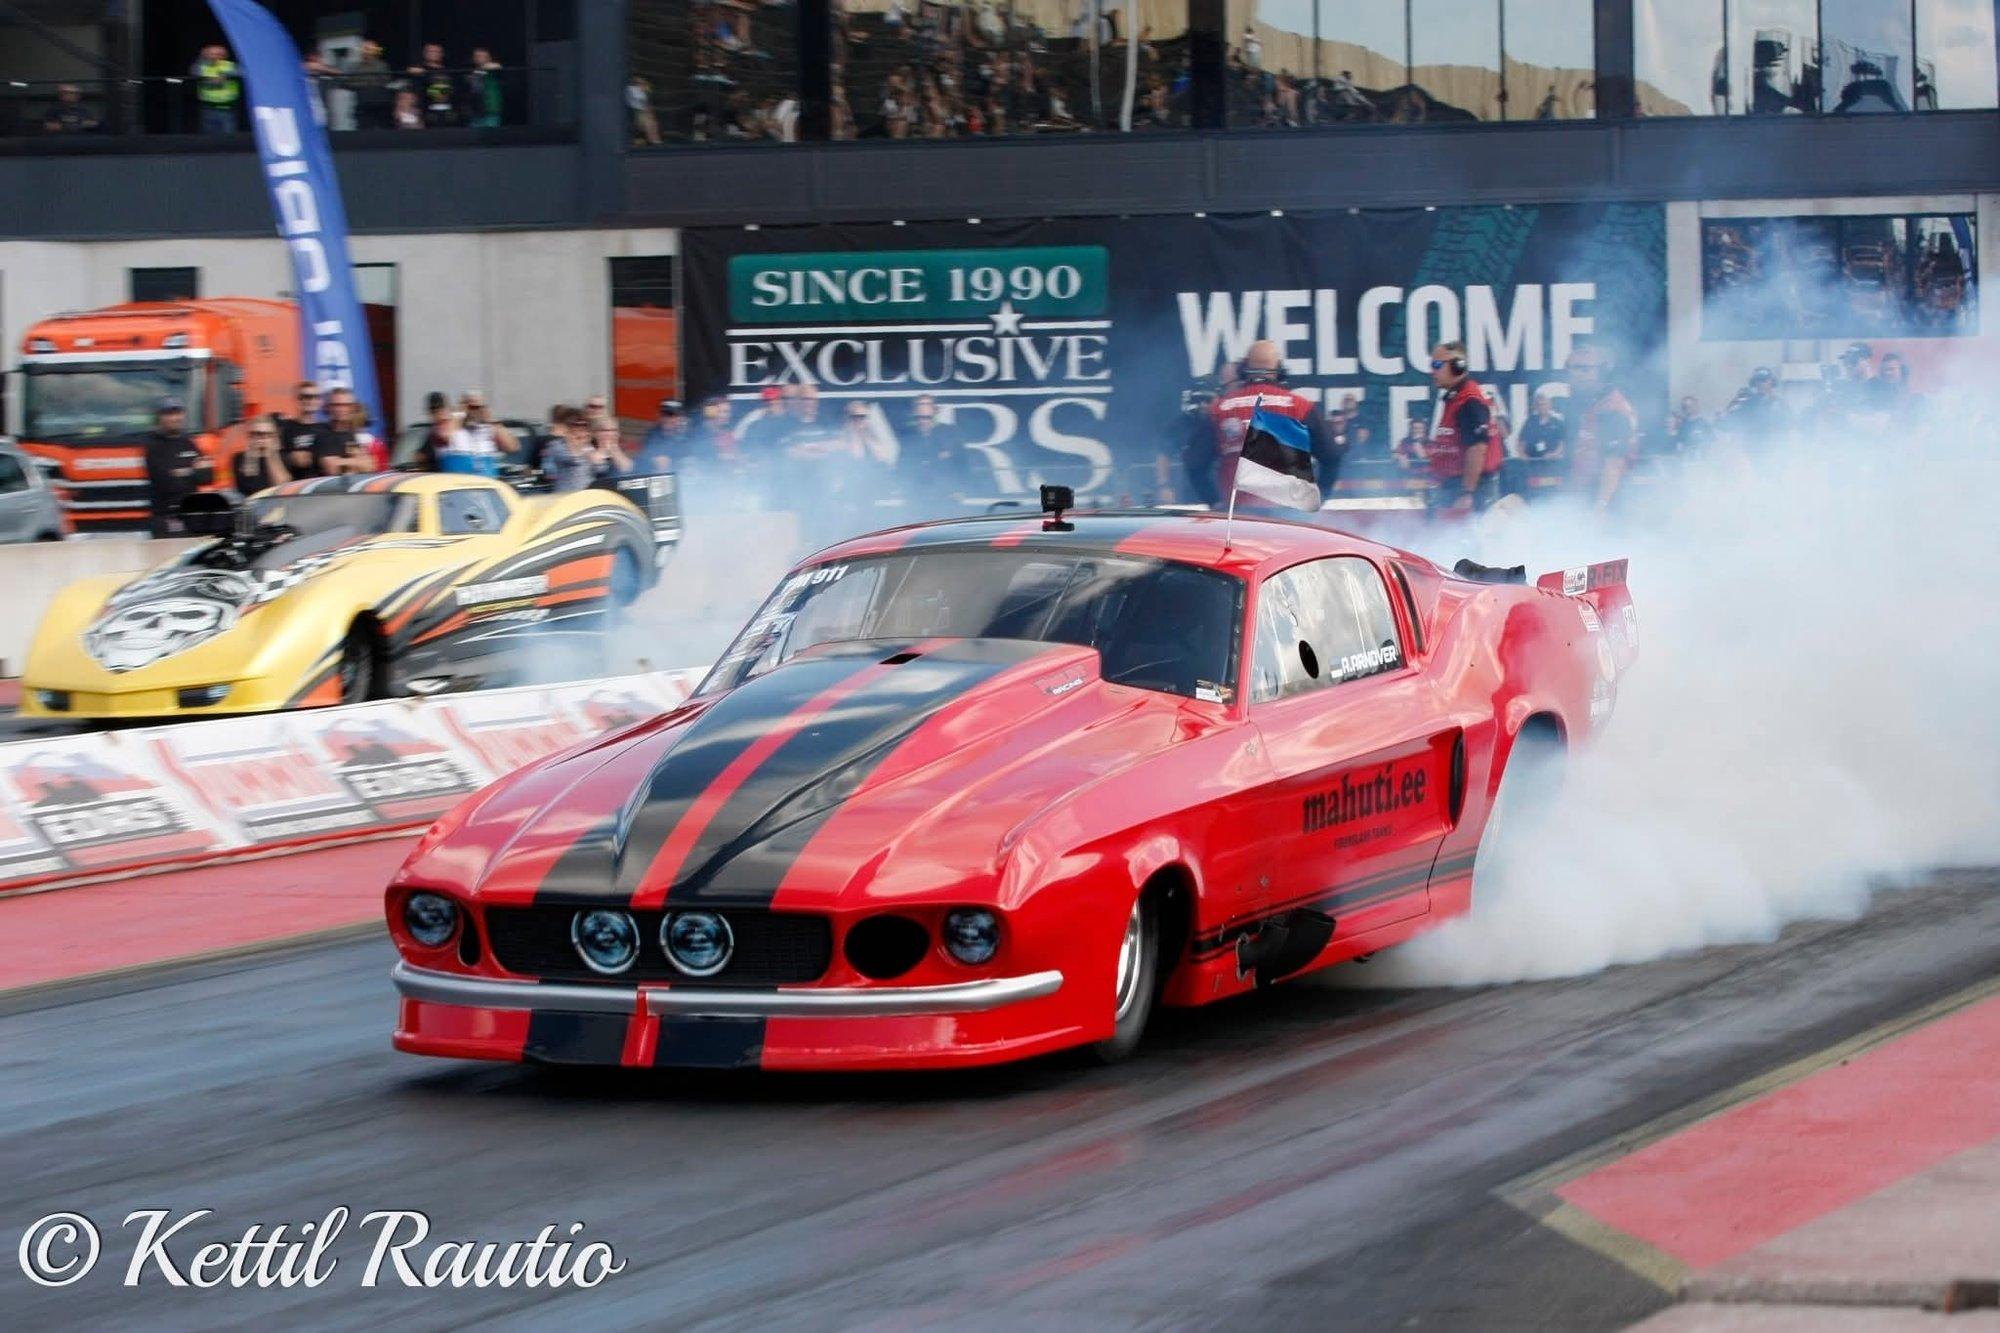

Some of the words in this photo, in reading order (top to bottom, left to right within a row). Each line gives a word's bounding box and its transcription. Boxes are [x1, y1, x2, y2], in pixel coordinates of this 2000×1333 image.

[752, 268, 926, 306] SINCE
[948, 264, 1083, 302] 1990
[729, 335, 1110, 388] EXCLUSIVE
[1177, 283, 1596, 378] WELCOME
[733, 398, 1112, 496] RS
[811, 565, 849, 584] 911
[1303, 762, 1425, 834] mahuti.ee
